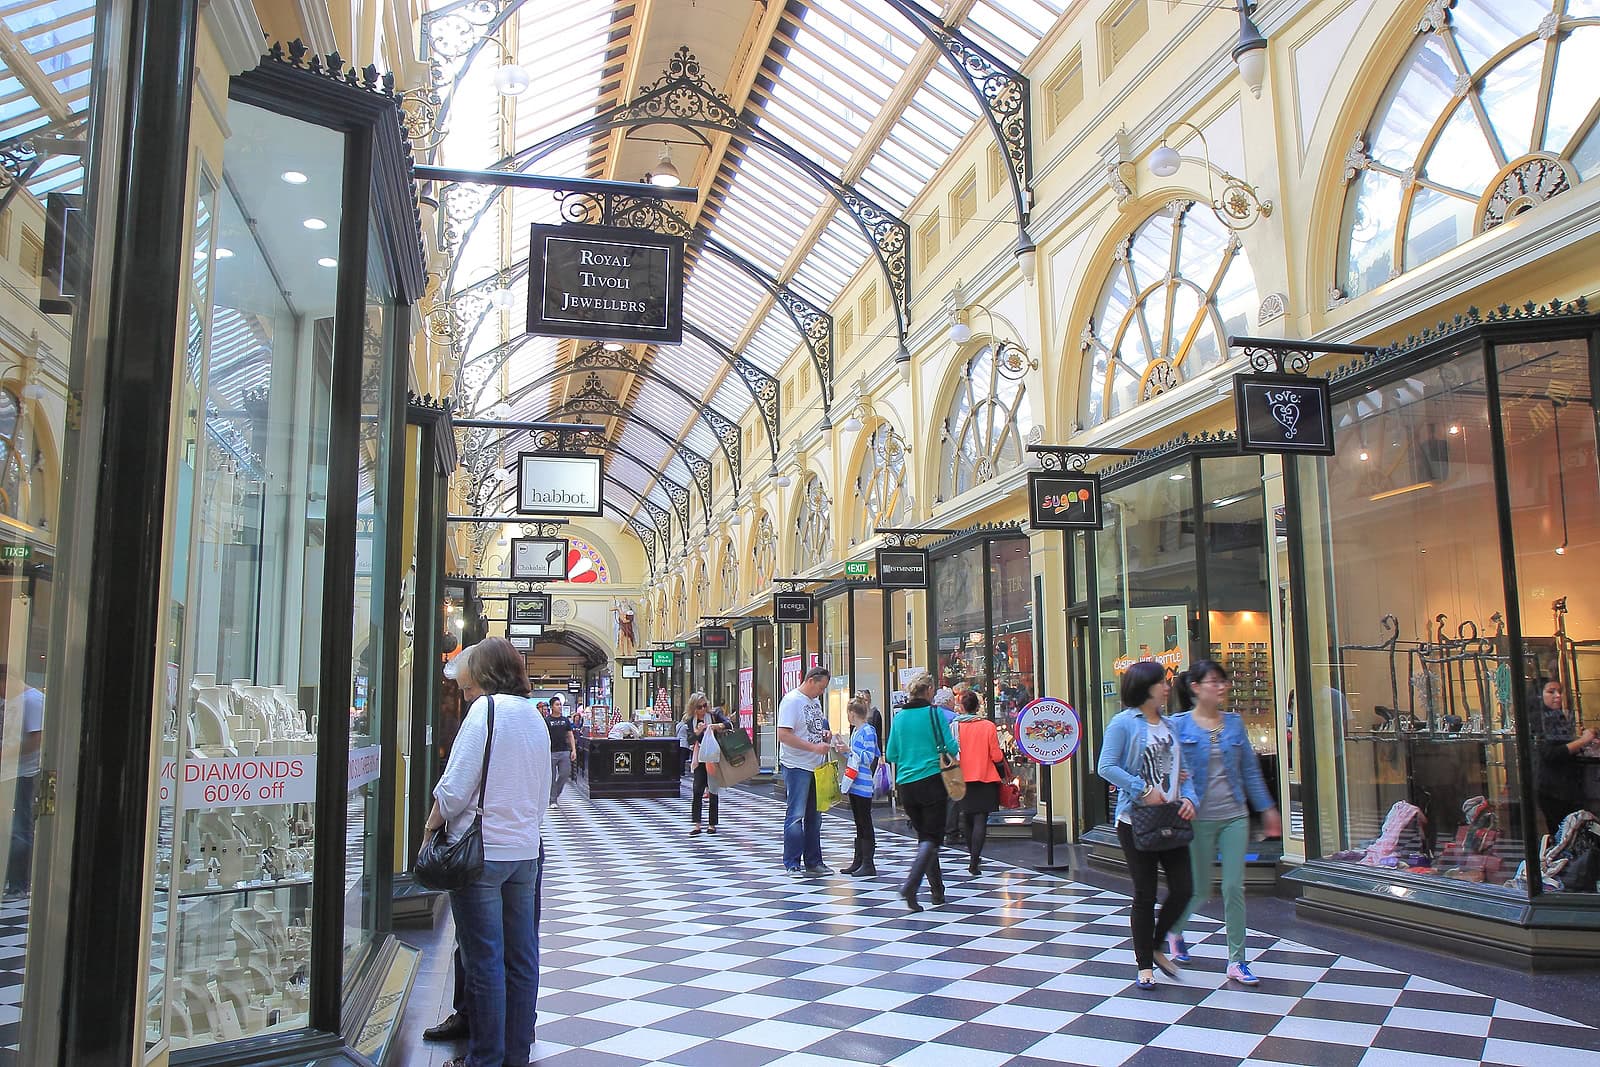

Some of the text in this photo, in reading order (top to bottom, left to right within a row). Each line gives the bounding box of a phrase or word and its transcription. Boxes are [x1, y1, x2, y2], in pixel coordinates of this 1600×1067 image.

[580, 250, 631, 268] ROYAL
[579, 271, 631, 290] TIVOLI
[561, 292, 646, 313] JEWELLERS
[532, 488, 589, 504] habbot.
[850, 563, 866, 573] EXIT
[1031, 703, 1066, 716] Design
[1028, 743, 1069, 756] your own
[185, 760, 304, 783] DIAMONDS
[204, 781, 285, 802] 60% off
